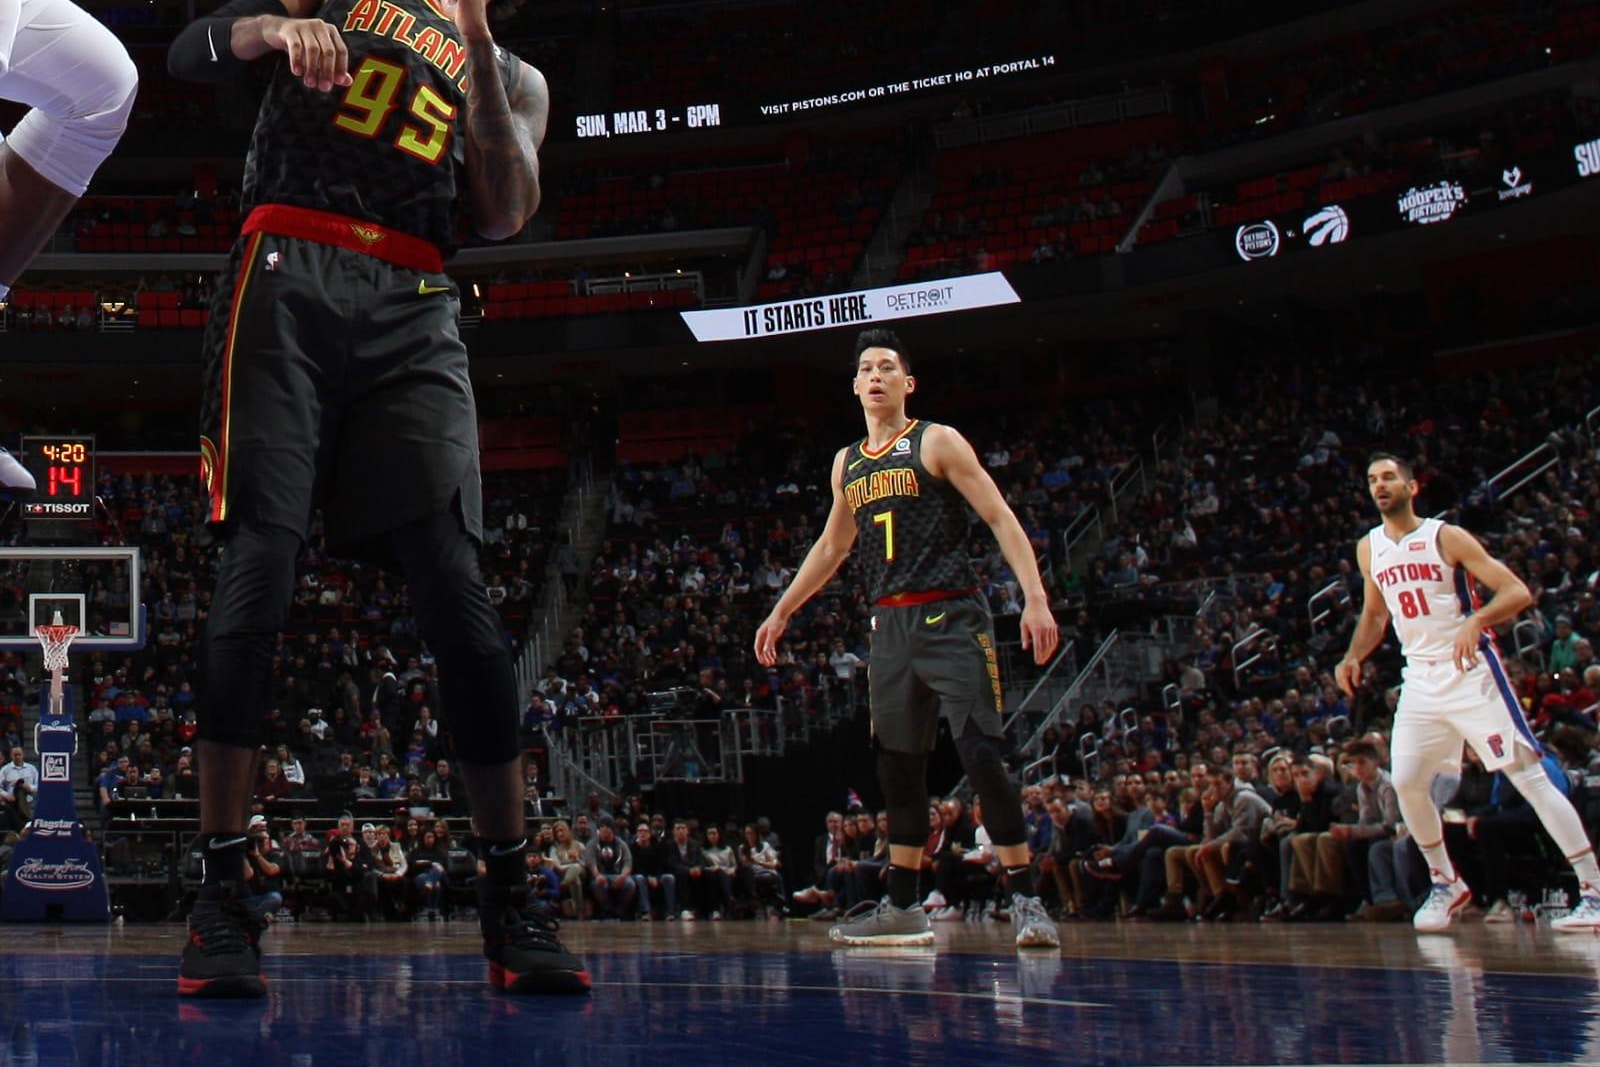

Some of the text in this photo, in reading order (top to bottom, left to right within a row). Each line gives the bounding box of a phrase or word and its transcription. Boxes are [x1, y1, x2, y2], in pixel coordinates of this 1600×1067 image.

[760, 55, 1055, 115] VISIT PISTONS.COM OR THE TICKET HQ AT PORTAL 14
[334, 54, 458, 166] 95
[576, 104, 720, 138] SUN, MAR. 3 6PM
[1574, 138, 1600, 177] SU
[886, 286, 953, 308] DETROIT
[744, 294, 872, 336] IT STARTS HERE.
[43, 444, 84, 462] 4:20
[48, 466, 80, 496] 14
[845, 468, 919, 514] ATLANTA
[873, 510, 894, 561] 7
[1376, 563, 1443, 590] PISTONS
[1398, 587, 1431, 619] 81
[34, 818, 75, 830] Flagstar
